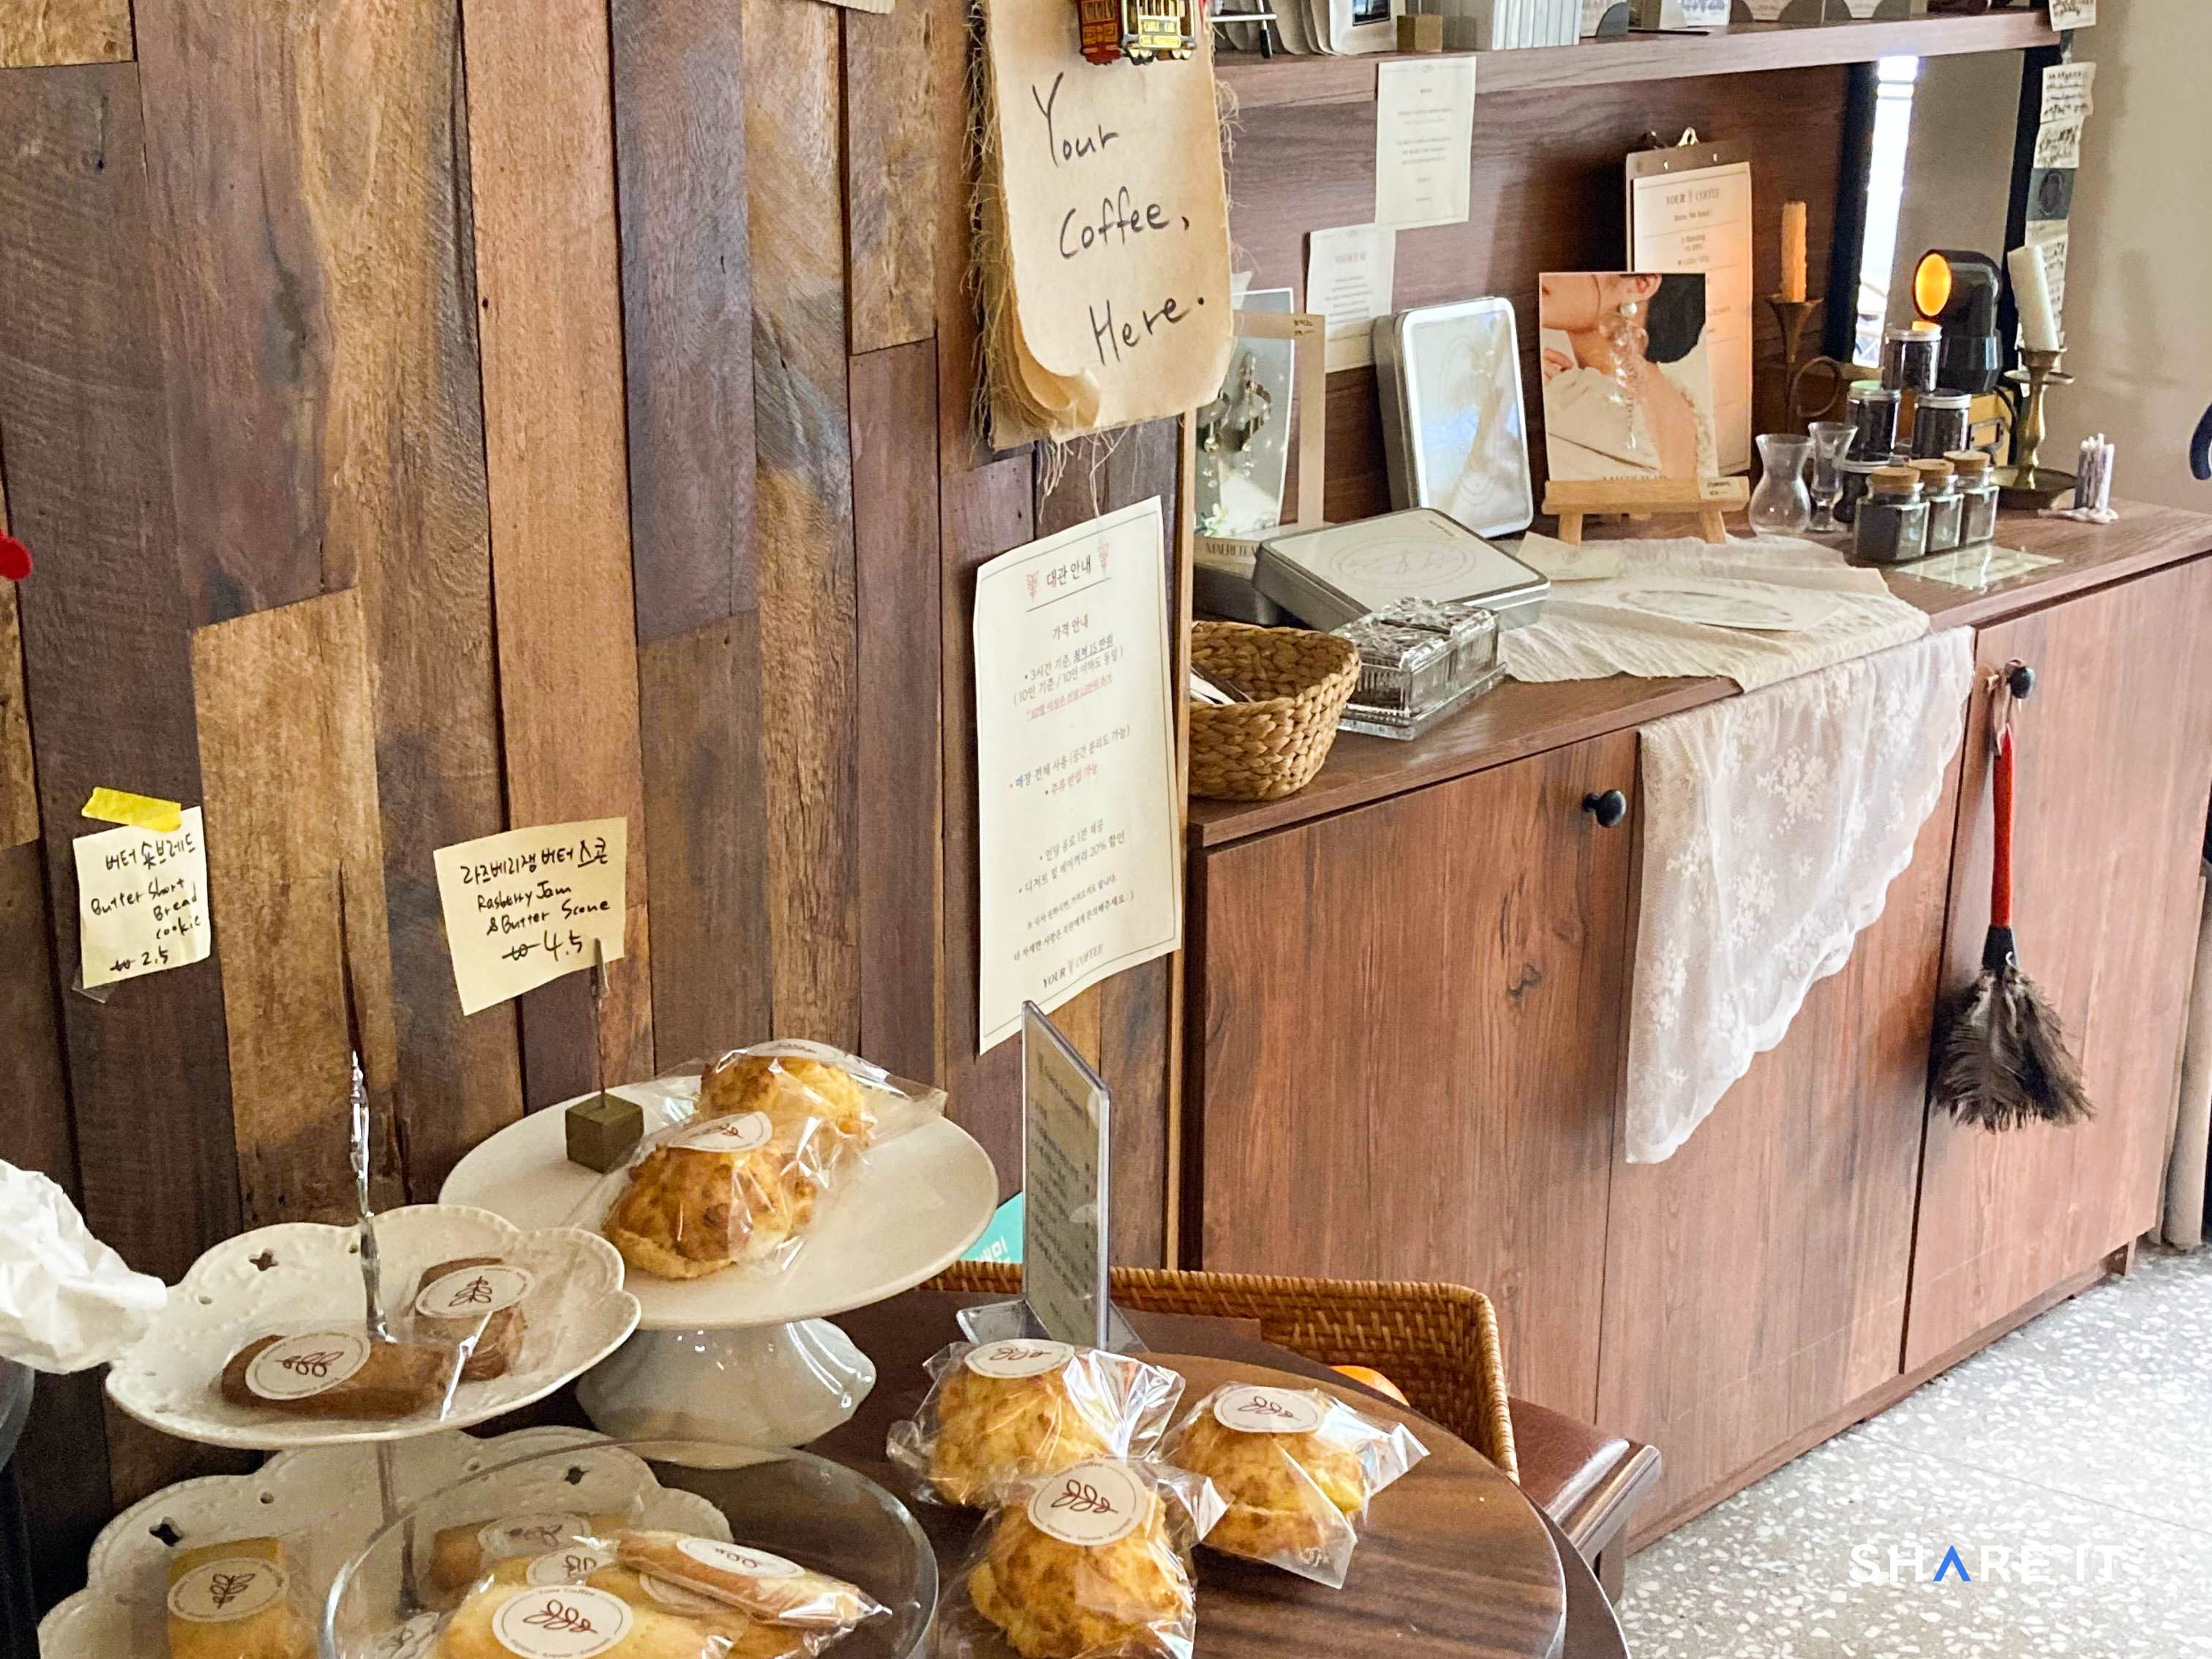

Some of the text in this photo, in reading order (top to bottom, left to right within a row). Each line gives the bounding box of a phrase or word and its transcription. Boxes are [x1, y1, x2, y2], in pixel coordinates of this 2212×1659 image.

[1031, 72, 1118, 168] Your
[1058, 186, 1190, 259] Coffee,
[1088, 295, 1205, 364] Here.
[1046, 554, 1092, 587] 대관 안내
[1053, 612, 1089, 641] 가격 안내
[105, 849, 138, 871] 버터
[541, 846, 573, 865] 버터
[577, 836, 609, 868] 스콘
[91, 876, 184, 916] Butter Short
[153, 881, 198, 922] Bread
[536, 880, 572, 900] Jam
[561, 898, 611, 919] Scone
[543, 929, 583, 962] 4.5
[1043, 967, 1066, 988] YOUR
